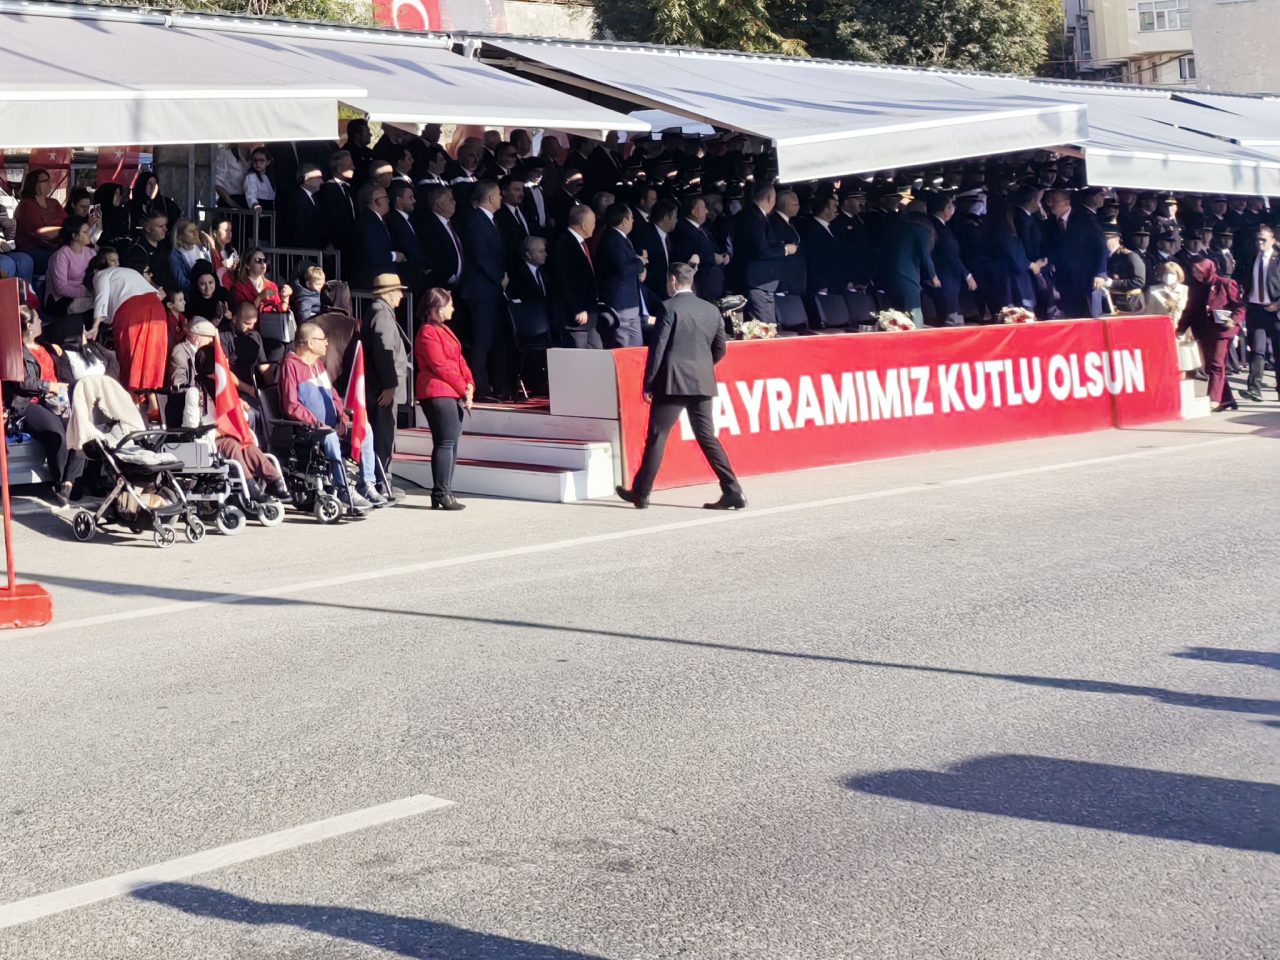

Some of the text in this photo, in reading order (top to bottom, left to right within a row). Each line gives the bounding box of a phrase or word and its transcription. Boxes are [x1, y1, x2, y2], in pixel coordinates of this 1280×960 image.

[680, 349, 1145, 441] AYRAMIMIZ KUTLU OLSUN
